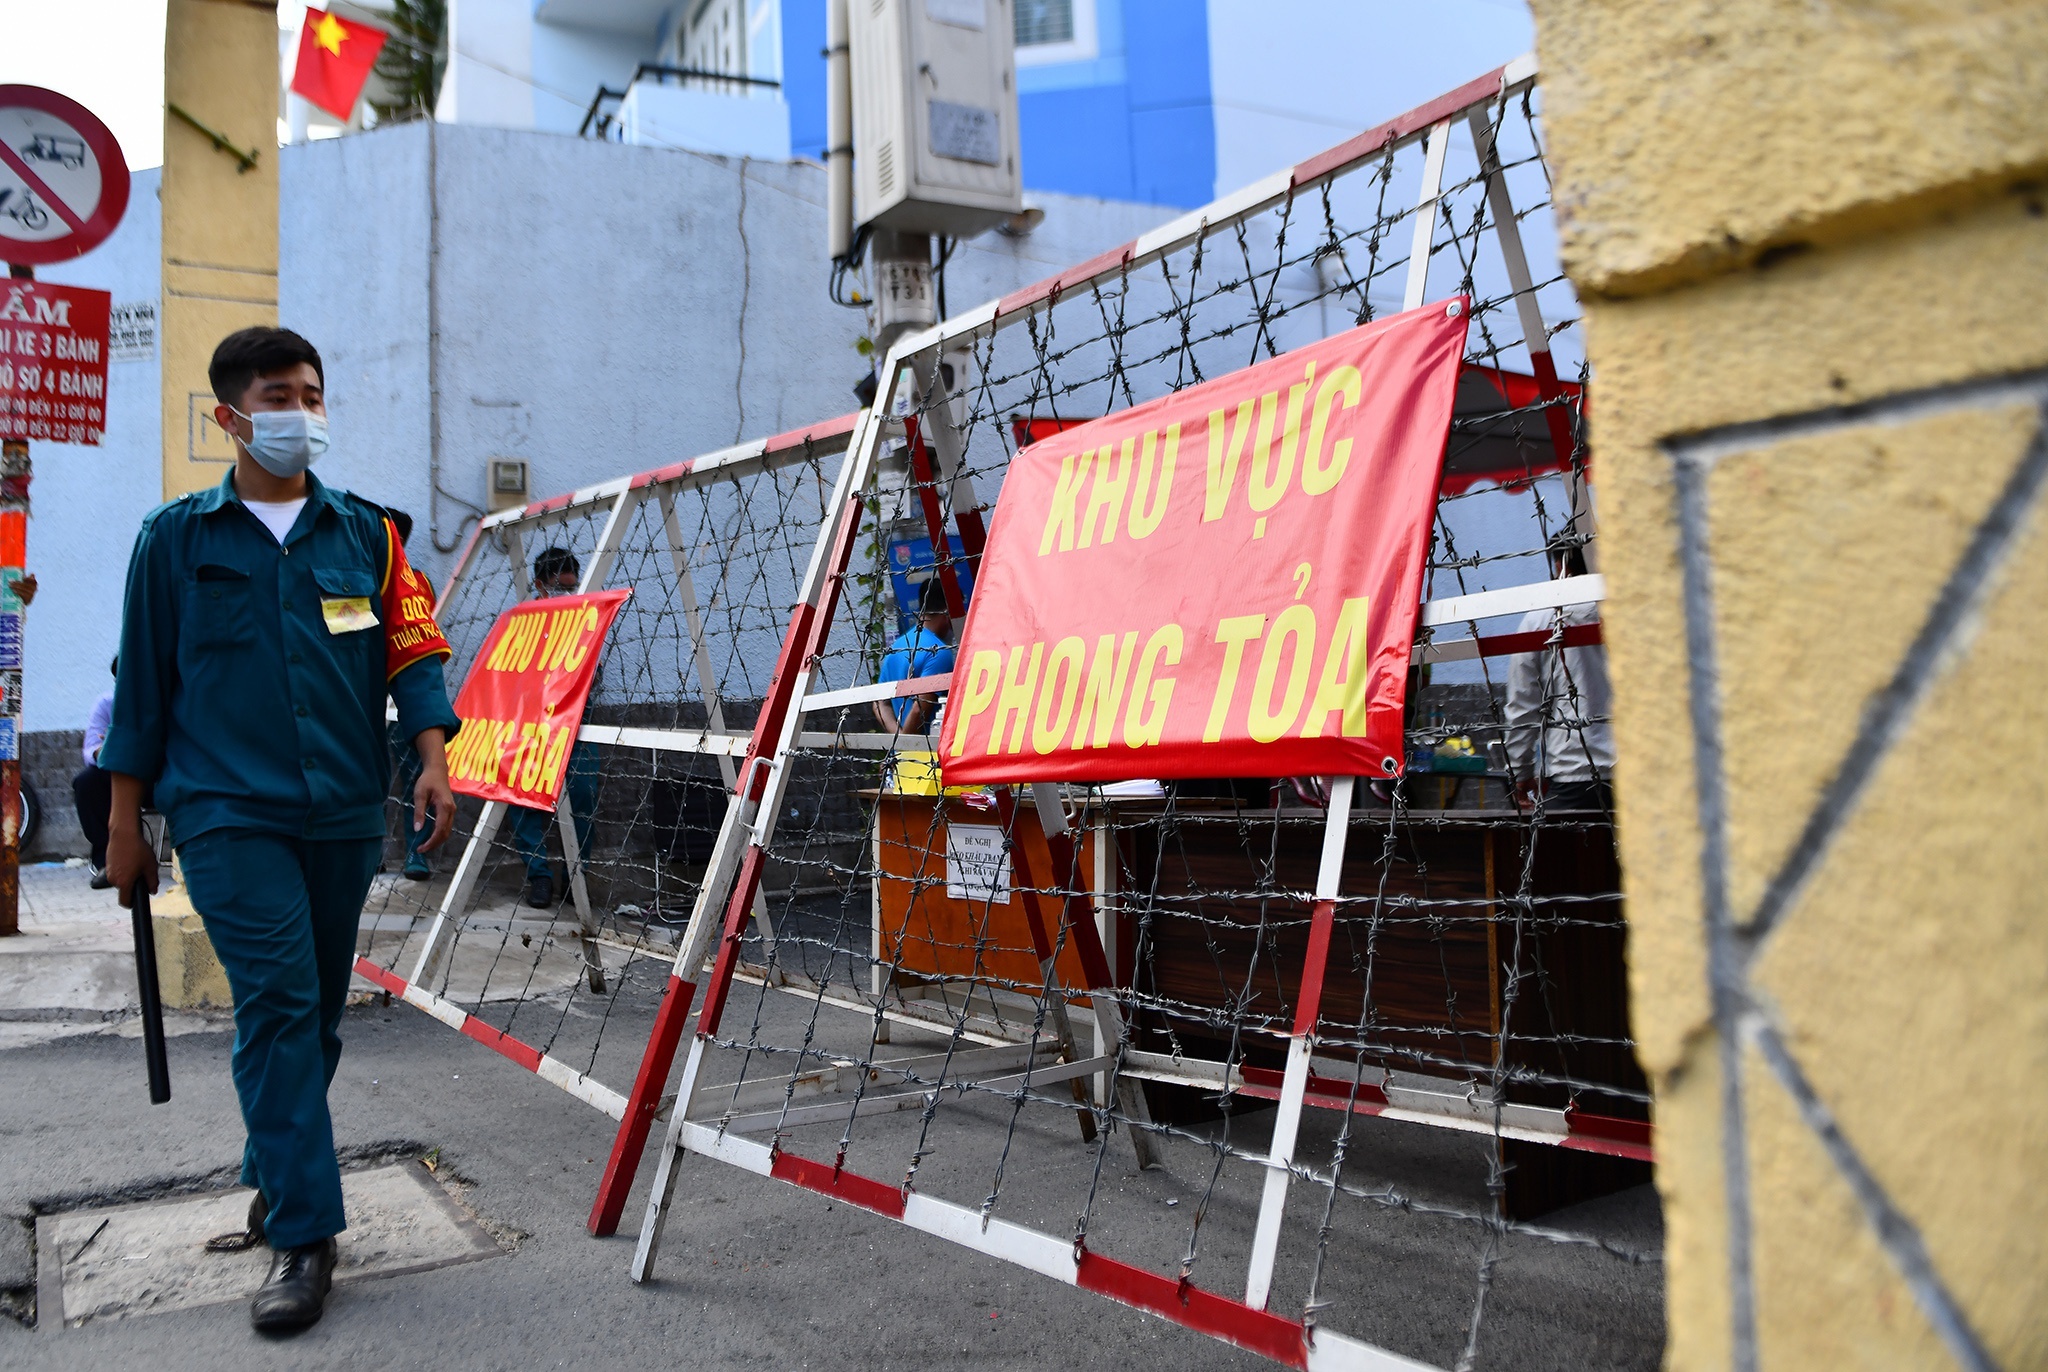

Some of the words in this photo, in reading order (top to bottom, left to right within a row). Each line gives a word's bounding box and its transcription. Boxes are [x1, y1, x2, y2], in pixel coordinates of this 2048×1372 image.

[14, 329, 37, 357] XE
[40, 331, 52, 358] 3
[55, 330, 100, 364] BÁNH
[44, 368, 55, 395] 4
[59, 365, 104, 400] BÁNH
[1037, 424, 1181, 557] KHU
[1202, 360, 1362, 541] VỰC
[486, 611, 548, 673] KHU
[536, 600, 599, 686] VỰC
[950, 623, 1184, 758] PHONG
[1202, 562, 1370, 743] TỎA
[507, 702, 571, 795] TỎA
